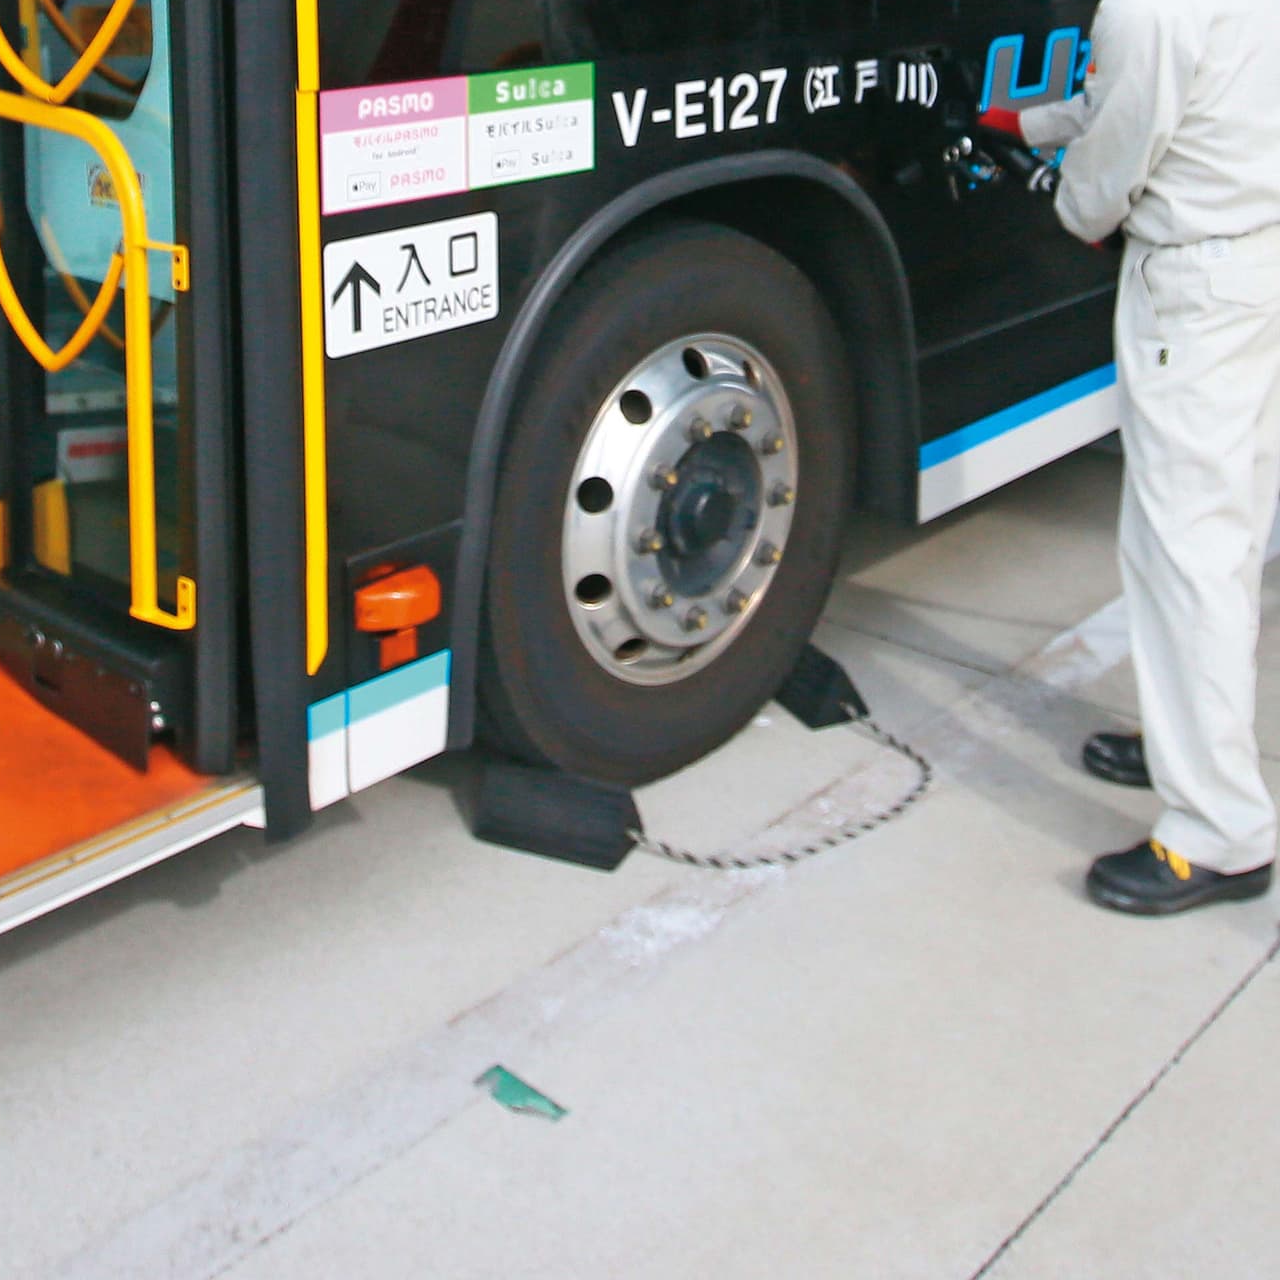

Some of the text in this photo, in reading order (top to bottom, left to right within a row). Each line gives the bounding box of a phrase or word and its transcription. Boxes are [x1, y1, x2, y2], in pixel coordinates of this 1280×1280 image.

[358, 91, 434, 119] PASMO
[495, 78, 566, 103] Suica
[611, 67, 788, 148] V-E127
[389, 167, 446, 188] PASMO
[396, 231, 479, 293] 入口
[382, 283, 492, 334] ENTRANCE
